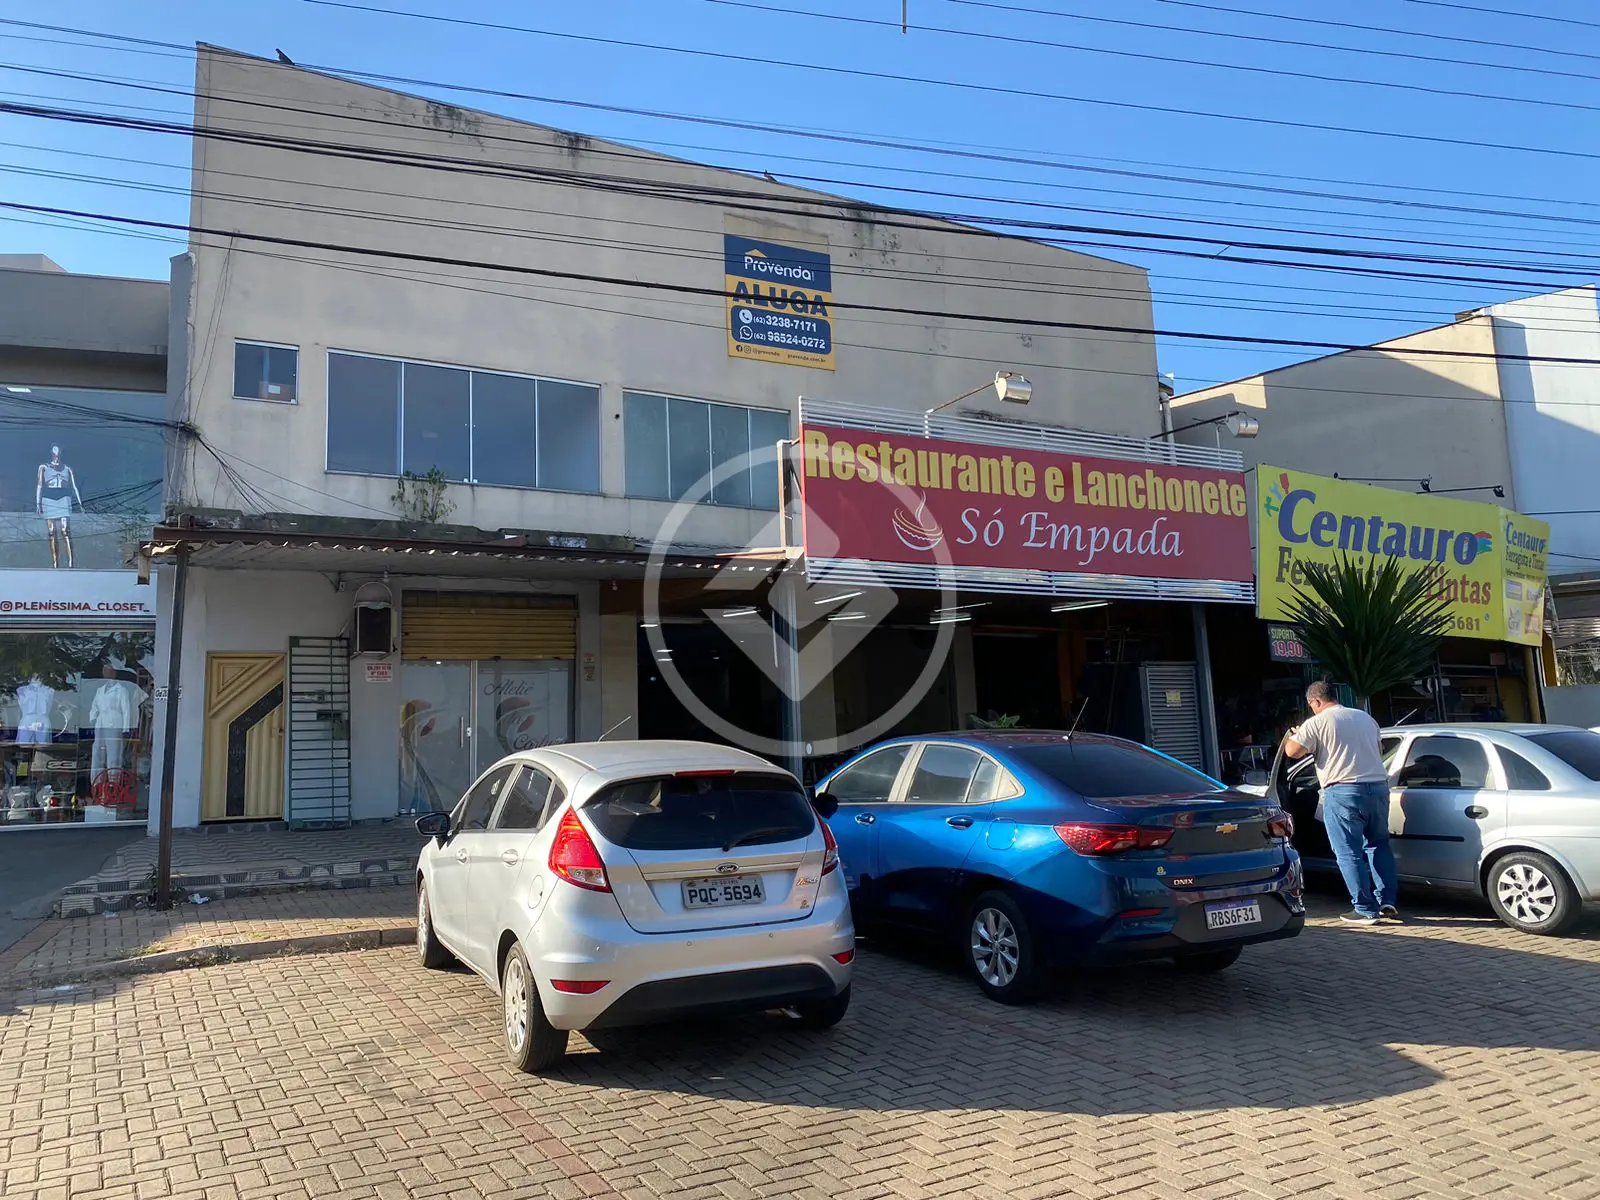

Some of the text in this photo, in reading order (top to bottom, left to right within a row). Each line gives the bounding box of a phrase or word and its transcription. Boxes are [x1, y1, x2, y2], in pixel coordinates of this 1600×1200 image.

[744, 256, 812, 281] Provenda
[732, 281, 829, 317] ALUGA
[766, 315, 817, 333] 3238-7171
[804, 430, 1247, 517] Restaurante e Lanchonete
[956, 508, 1184, 566] Só Empada
[1277, 489, 1478, 566] Centauro
[1505, 521, 1544, 554] Centauro
[1211, 906, 1256, 927] RBS6F31
